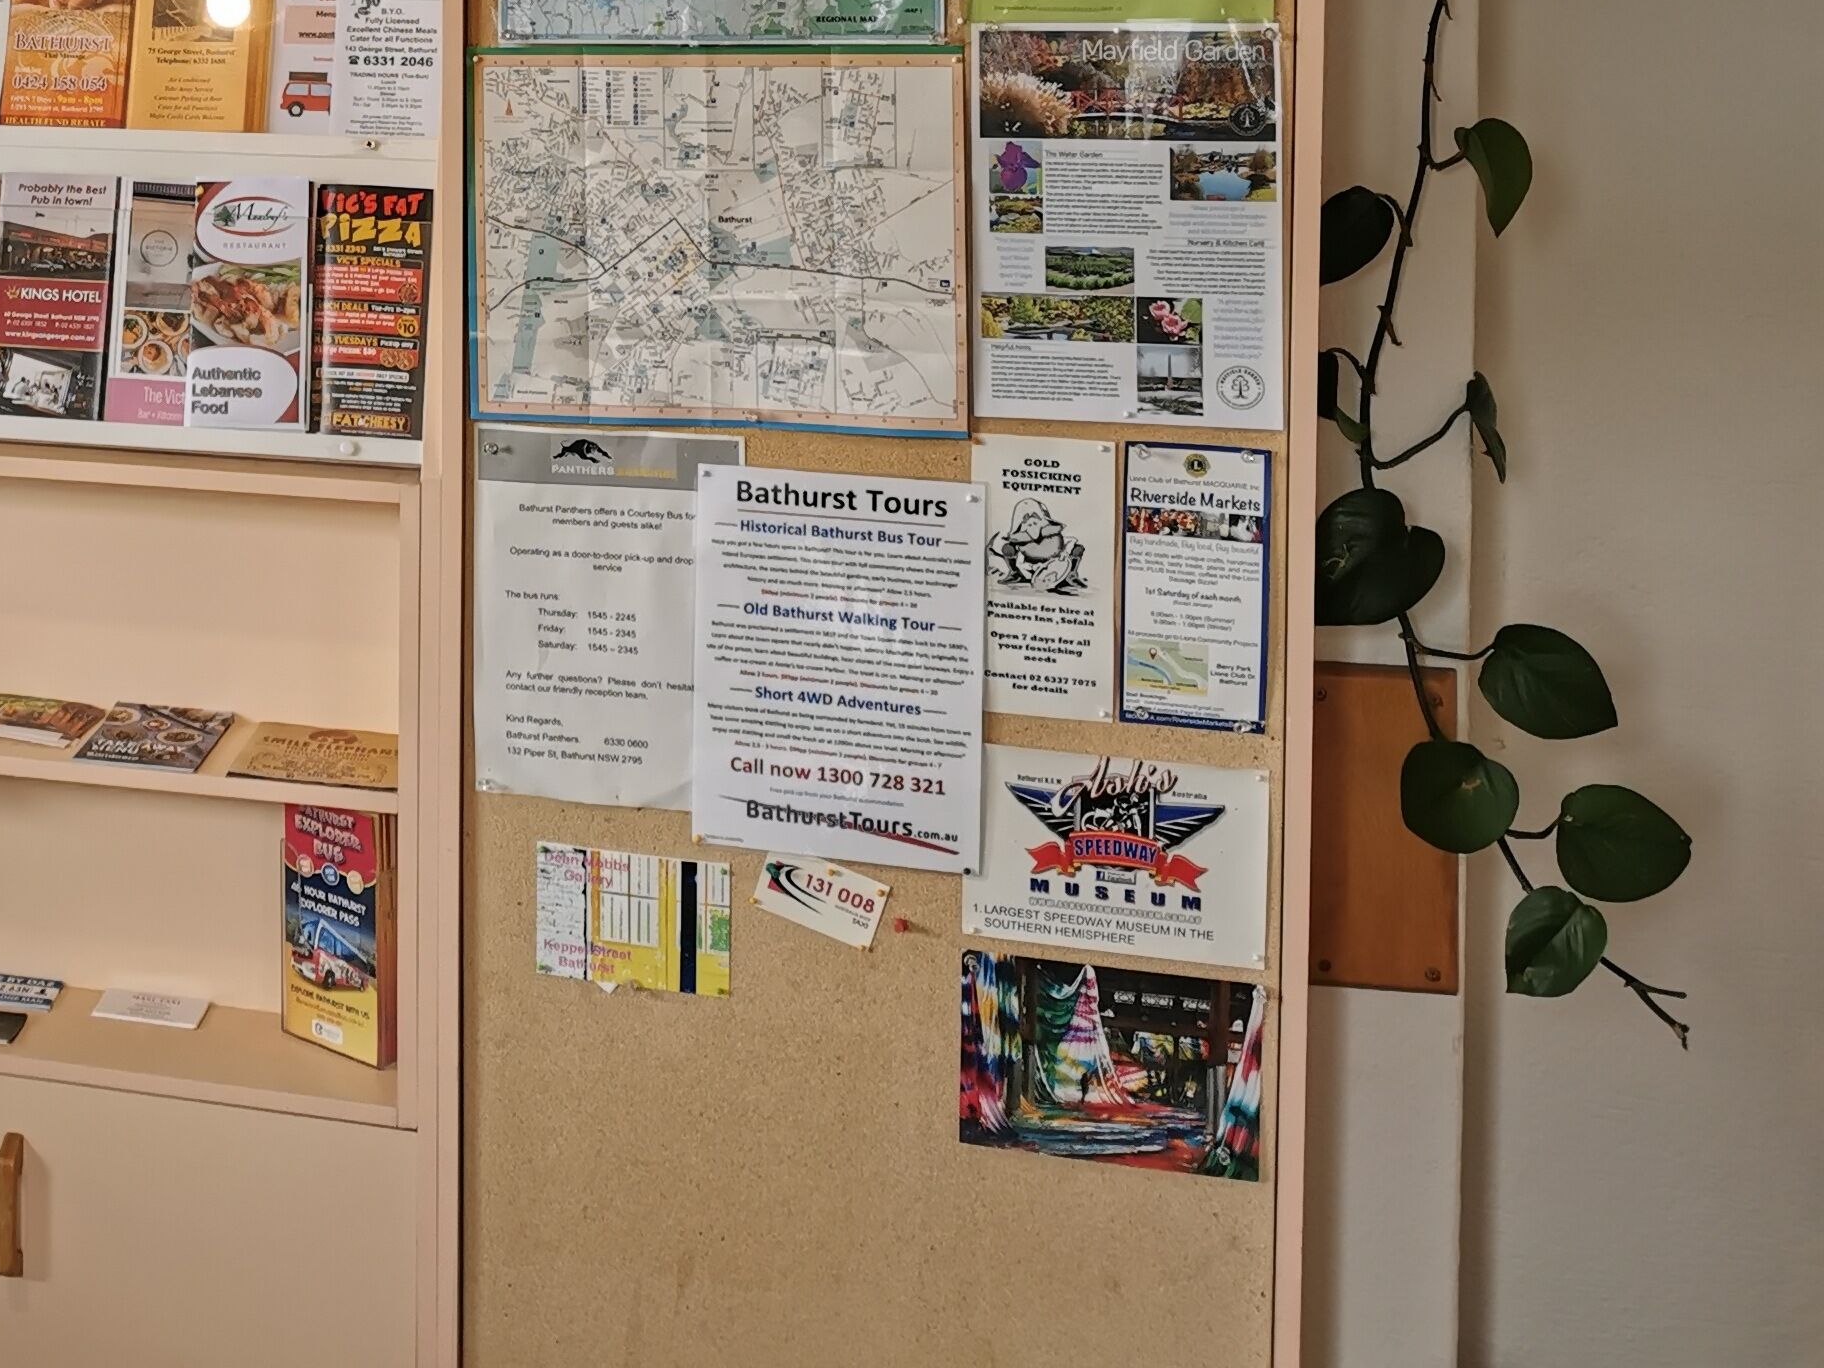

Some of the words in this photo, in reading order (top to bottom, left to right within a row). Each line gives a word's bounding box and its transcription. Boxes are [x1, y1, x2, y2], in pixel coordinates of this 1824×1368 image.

[15, 33, 112, 52] BATHURST
[1082, 39, 1177, 65] Mayfield
[1185, 39, 1266, 63] Garden
[363, 56, 395, 65] 6331
[401, 57, 433, 66] 2046
[18, 183, 64, 195] Probably
[66, 185, 84, 194] the
[86, 185, 106, 195] Best
[31, 196, 50, 205] Pub
[52, 196, 62, 205] in
[64, 196, 93, 206] town!
[322, 190, 377, 214] VIC'S
[384, 192, 424, 216] FAT
[717, 215, 753, 225] Bathurst
[20, 288, 59, 301] KINGS
[62, 288, 102, 303] HOTEL
[192, 367, 261, 381] Authentic
[192, 384, 263, 398] Lebanese
[191, 402, 229, 415] Food
[551, 463, 615, 476] PANTHERS
[1024, 458, 1060, 469] GOLD
[1002, 469, 1082, 483] FOSSICKING
[1002, 481, 1082, 495] EQUIPMENT
[737, 480, 858, 511] Bathurst
[866, 489, 948, 518] Tours
[1130, 487, 1196, 507] Riverside
[1200, 492, 1261, 512] Markets
[519, 503, 553, 513] Bathurst
[555, 506, 592, 515] Panthers
[594, 506, 618, 516] offers
[627, 508, 664, 520] Courtesy
[667, 511, 683, 520] Bus
[552, 517, 590, 527] members
[593, 518, 609, 527] and
[611, 520, 638, 531] guests
[740, 520, 807, 536] Historical
[811, 525, 873, 542] Bathurst
[878, 531, 903, 544] Bus
[907, 533, 941, 548] Tour
[510, 546, 550, 559] Operating
[572, 549, 622, 561] door-to-door
[625, 552, 655, 565] pick-up
[657, 555, 673, 564] and
[675, 555, 694, 566] drop
[593, 564, 622, 573] service
[744, 602, 768, 616] Old
[773, 604, 834, 623] Bathurst
[838, 611, 897, 630] Walking
[901, 617, 935, 632] Tour
[987, 600, 1037, 612] Available
[1041, 604, 1056, 613] for
[1059, 606, 1081, 616] hire
[1083, 608, 1094, 617] at
[755, 686, 794, 702] Short
[797, 689, 833, 706] 4WD
[837, 694, 921, 715] Adventures
[507, 746, 521, 756] 132
[524, 748, 545, 760] Piper
[561, 750, 596, 761] Bathurst
[597, 753, 619, 763] NSW
[622, 754, 642, 765] 2795
[731, 756, 764, 775] Call
[770, 760, 810, 780] now
[817, 767, 863, 786] 1300
[870, 772, 905, 791] 728
[910, 777, 946, 796] 321
[1074, 838, 1158, 864] SPEEDWAY
[805, 874, 833, 896] 131
[838, 888, 875, 913] 008
[1030, 878, 1202, 912] MUSEUM
[984, 904, 1040, 919] LARGEST
[1044, 911, 1113, 928] SPEEDWAY
[1116, 920, 1170, 936] MUSEUM
[1174, 926, 1186, 938] IN
[1190, 928, 1214, 942] THE
[984, 918, 1052, 935] SOUTHERN
[1054, 925, 1136, 946] HEMISPHERE
[6, 976, 25, 984] BY
